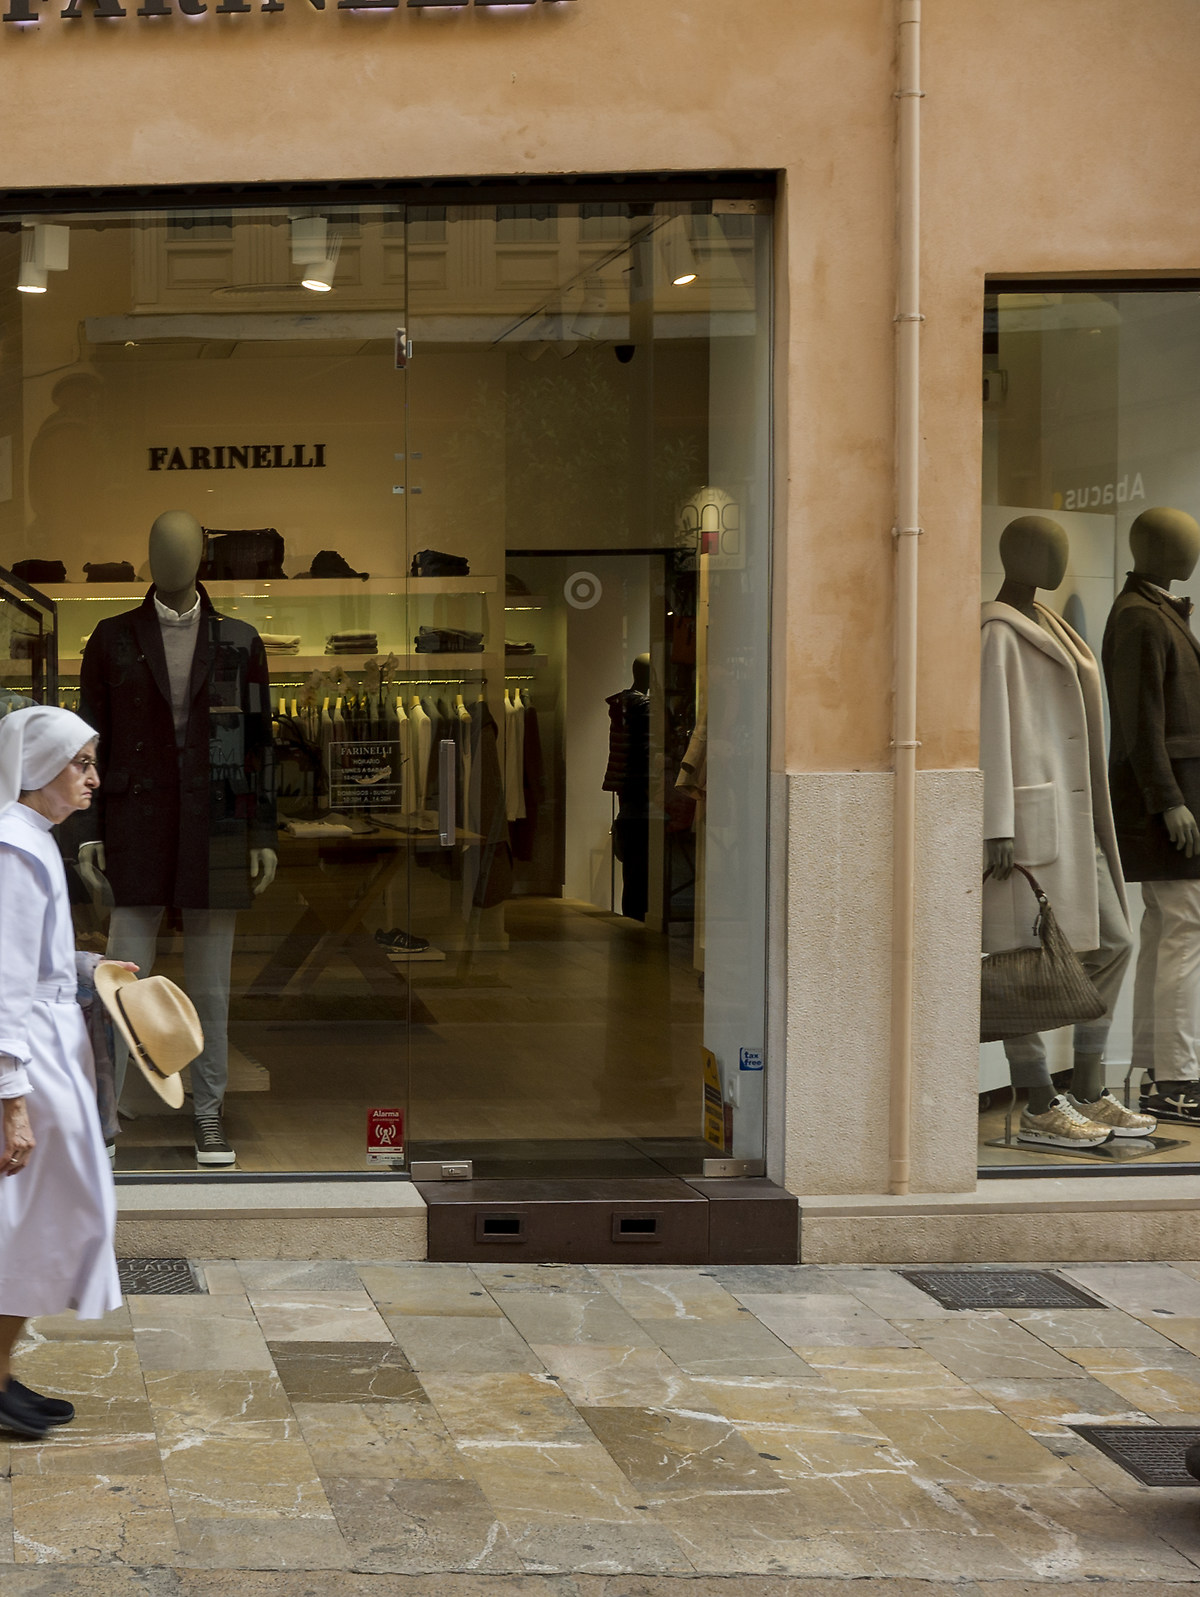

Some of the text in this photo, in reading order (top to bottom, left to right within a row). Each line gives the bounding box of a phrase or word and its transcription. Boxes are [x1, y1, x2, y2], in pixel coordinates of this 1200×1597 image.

[147, 443, 326, 471] FARINELLI
[341, 746, 392, 755] FARINELLI
[744, 1051, 759, 1059] tax
[744, 1059, 762, 1067] free
[373, 1110, 400, 1118] Alarma
